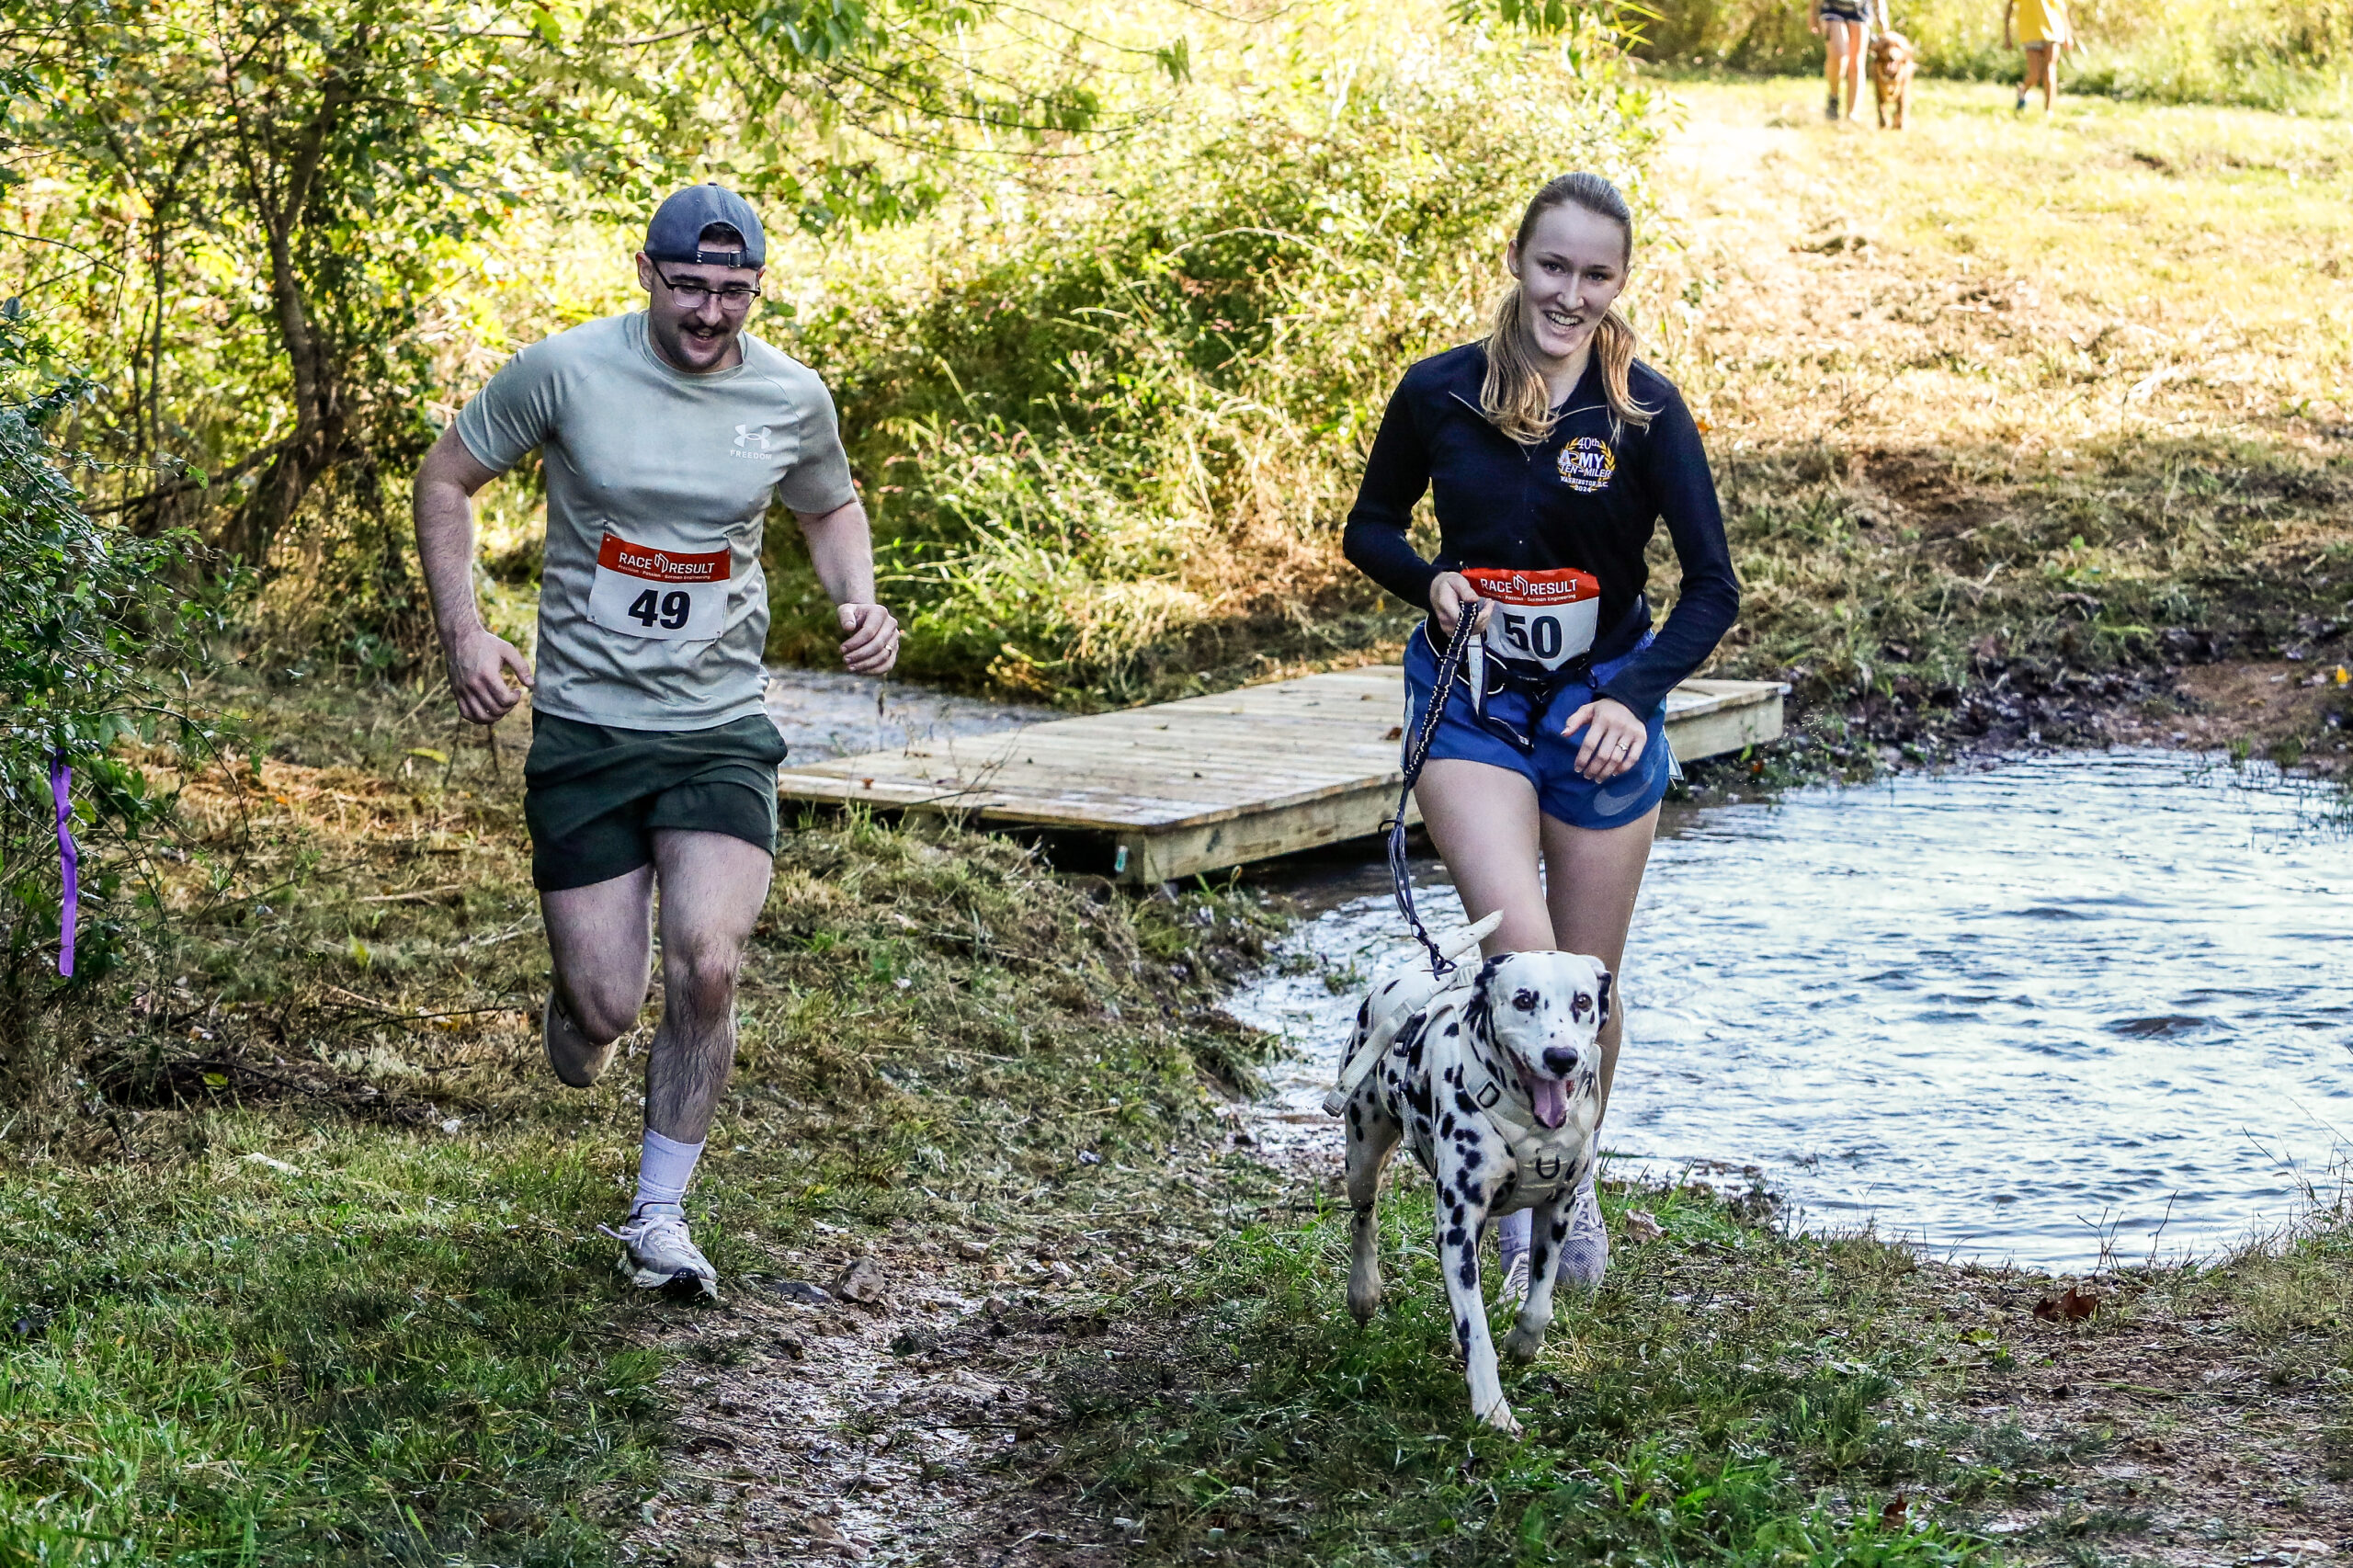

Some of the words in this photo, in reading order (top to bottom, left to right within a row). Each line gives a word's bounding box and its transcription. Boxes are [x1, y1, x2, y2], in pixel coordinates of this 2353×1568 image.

[1577, 437, 1599, 449] 40th
[730, 449, 772, 460] FREEDOM
[619, 551, 653, 570] RACE
[669, 562, 715, 574] RESULT
[642, 570, 662, 578] Passion
[1480, 578, 1513, 594] RACE
[1529, 578, 1577, 596] RESULT
[1548, 594, 1575, 602] Engineering
[628, 588, 690, 630] 49
[1502, 612, 1563, 660] 50
